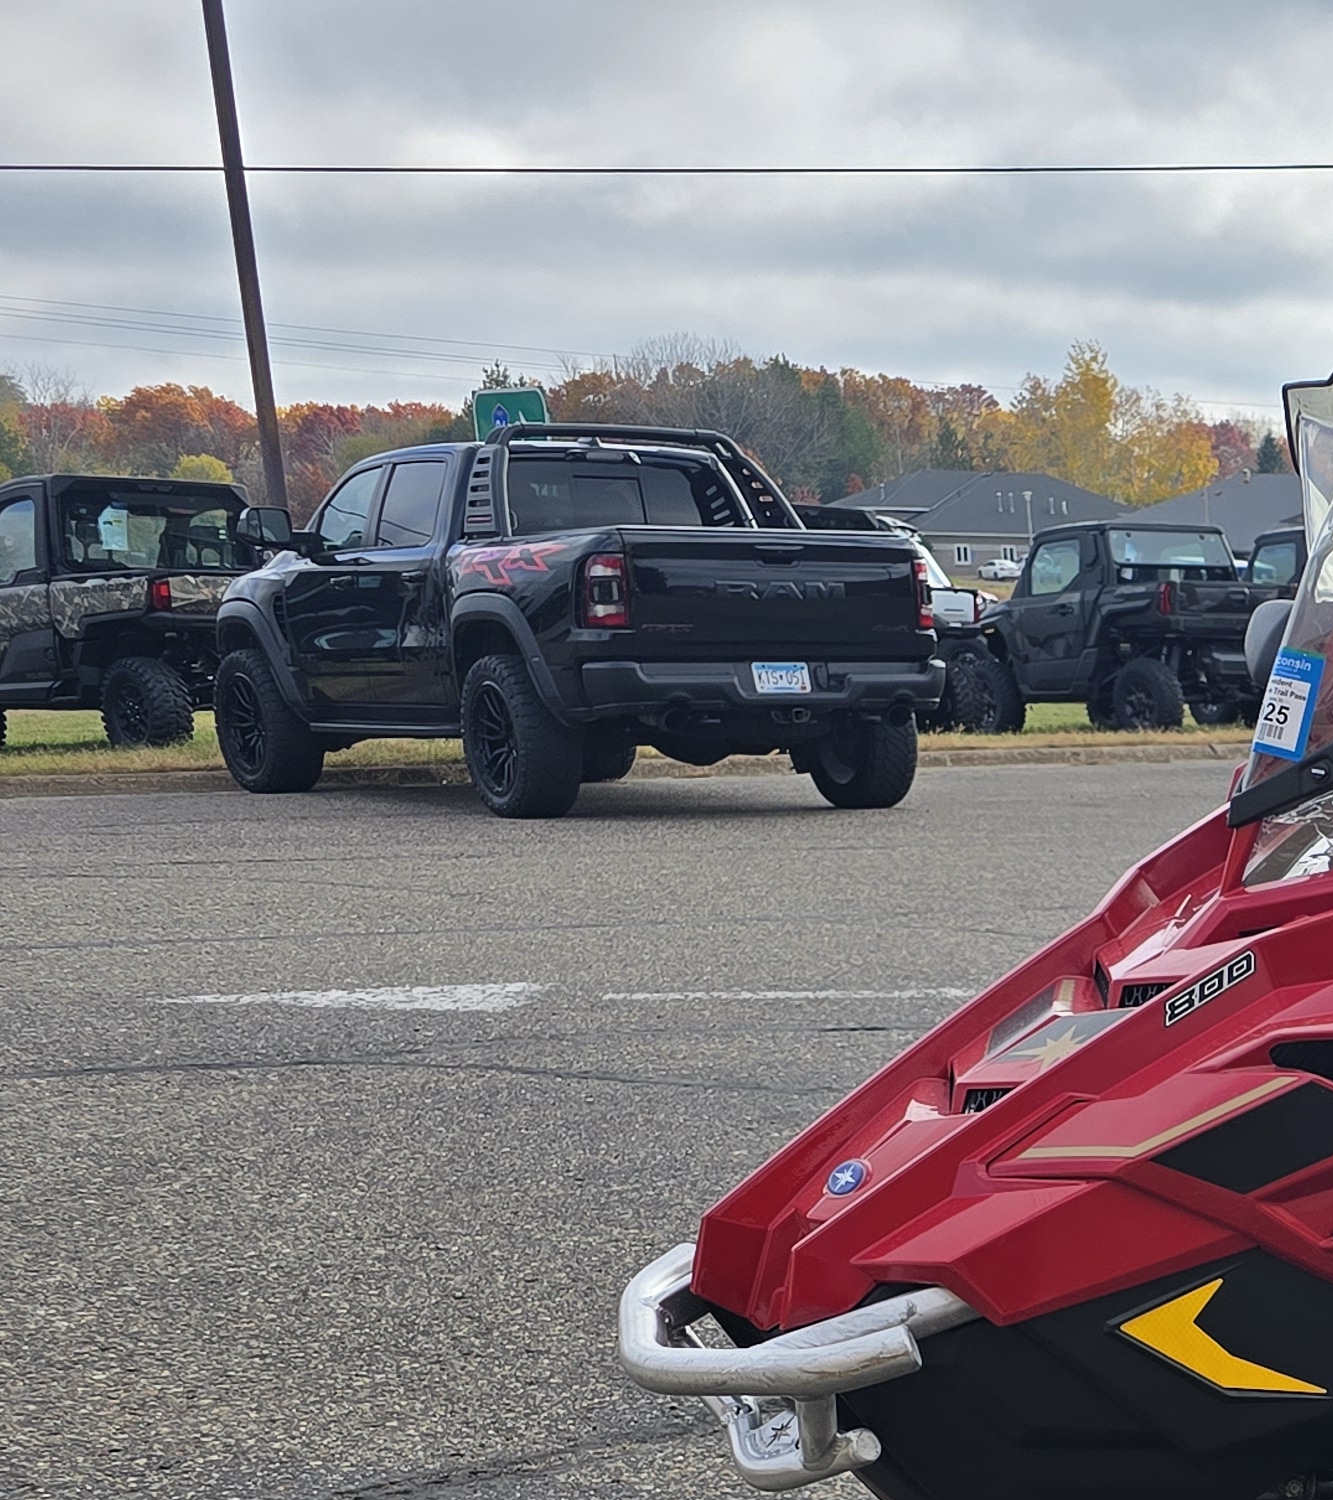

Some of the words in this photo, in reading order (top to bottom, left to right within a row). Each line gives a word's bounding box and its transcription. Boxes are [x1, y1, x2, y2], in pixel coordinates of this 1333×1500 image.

[715, 580, 846, 600] RAM
[1276, 655, 1312, 672] consin
[1263, 702, 1290, 725] 25
[1166, 950, 1255, 1027] 800
